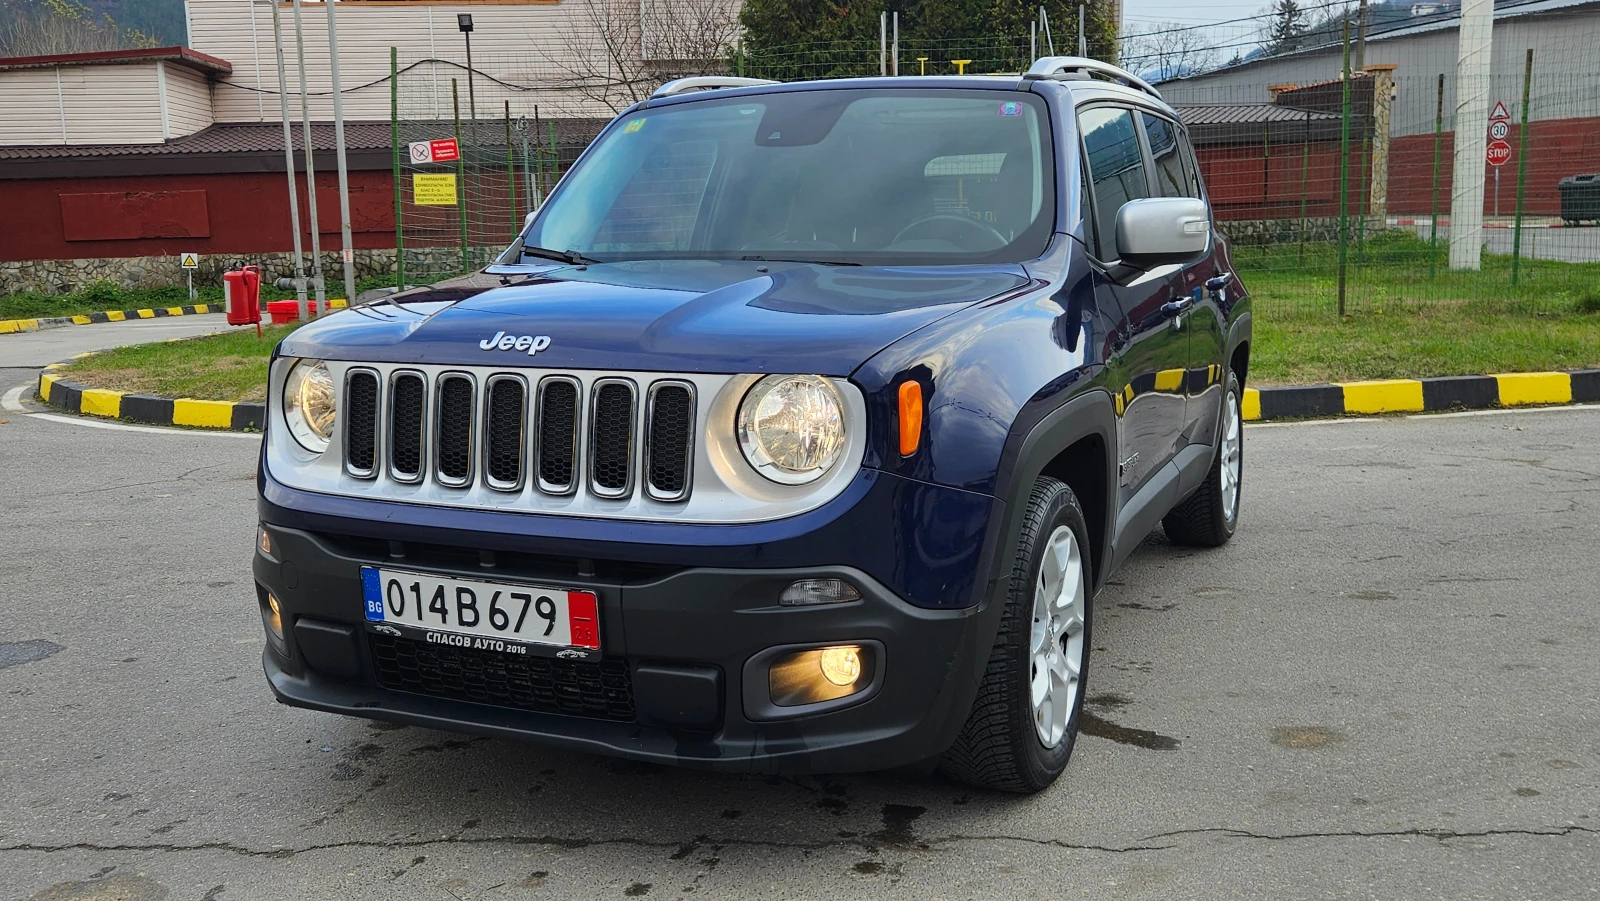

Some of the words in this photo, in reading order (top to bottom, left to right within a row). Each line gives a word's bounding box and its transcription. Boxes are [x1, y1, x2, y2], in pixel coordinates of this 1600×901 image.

[1493, 125, 1506, 136] 30
[1488, 148, 1509, 158] STOP
[479, 331, 551, 356] Jeep
[368, 601, 383, 613] BG
[426, 631, 471, 647] СПАСОВ
[473, 638, 504, 652] АУТО
[506, 645, 527, 655] 2016
